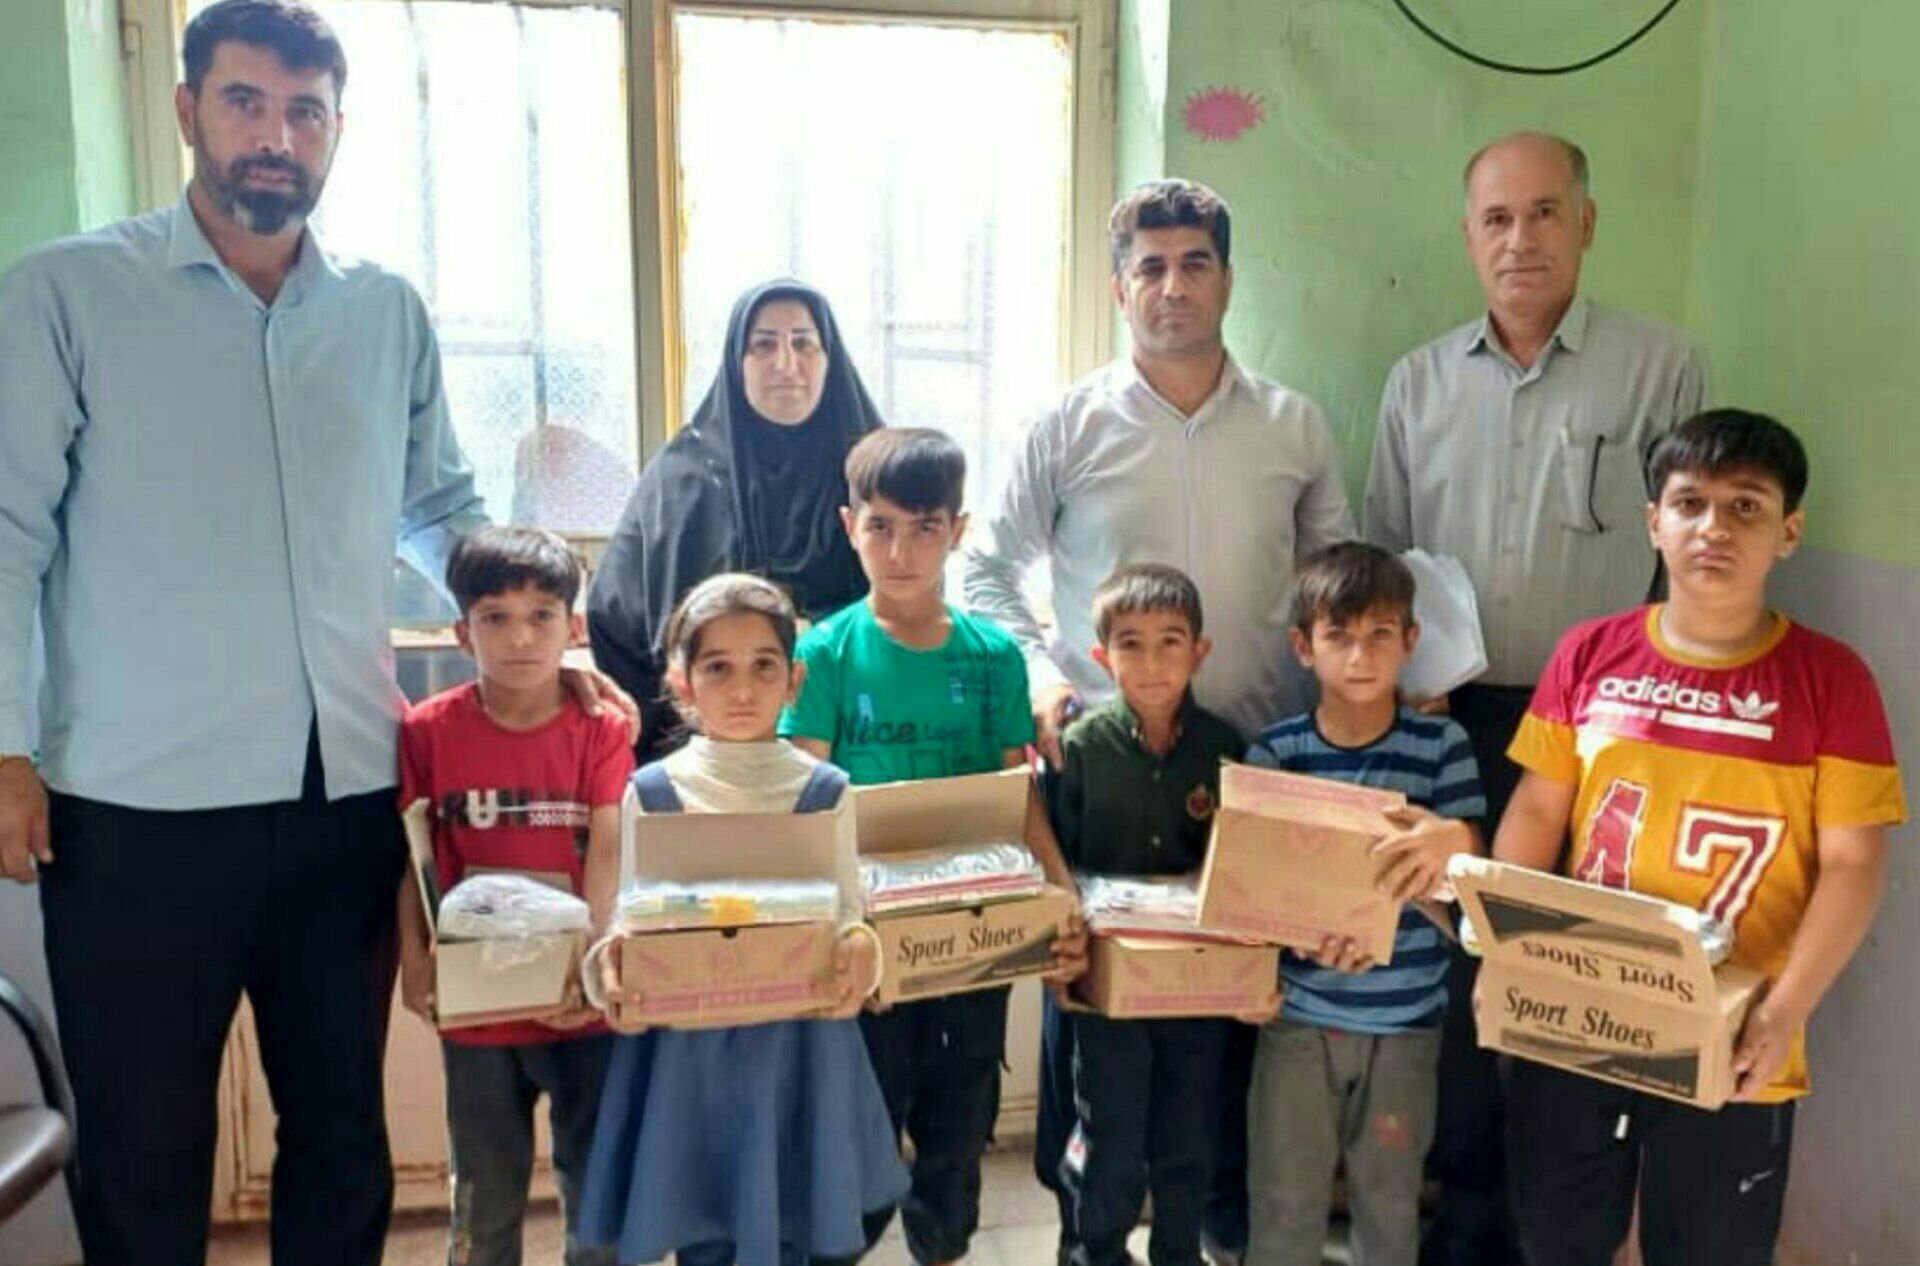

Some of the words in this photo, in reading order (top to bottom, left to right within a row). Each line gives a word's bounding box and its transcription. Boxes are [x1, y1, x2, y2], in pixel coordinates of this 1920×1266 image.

[1598, 675, 1721, 713] adidas
[897, 933, 956, 967] Sport
[966, 918, 1026, 952] Shoes
[1521, 940, 1601, 979] Shoes
[1620, 966, 1695, 1003] Sport
[1504, 986, 1569, 1026] Sport
[1581, 1002, 1657, 1050] Shoes
